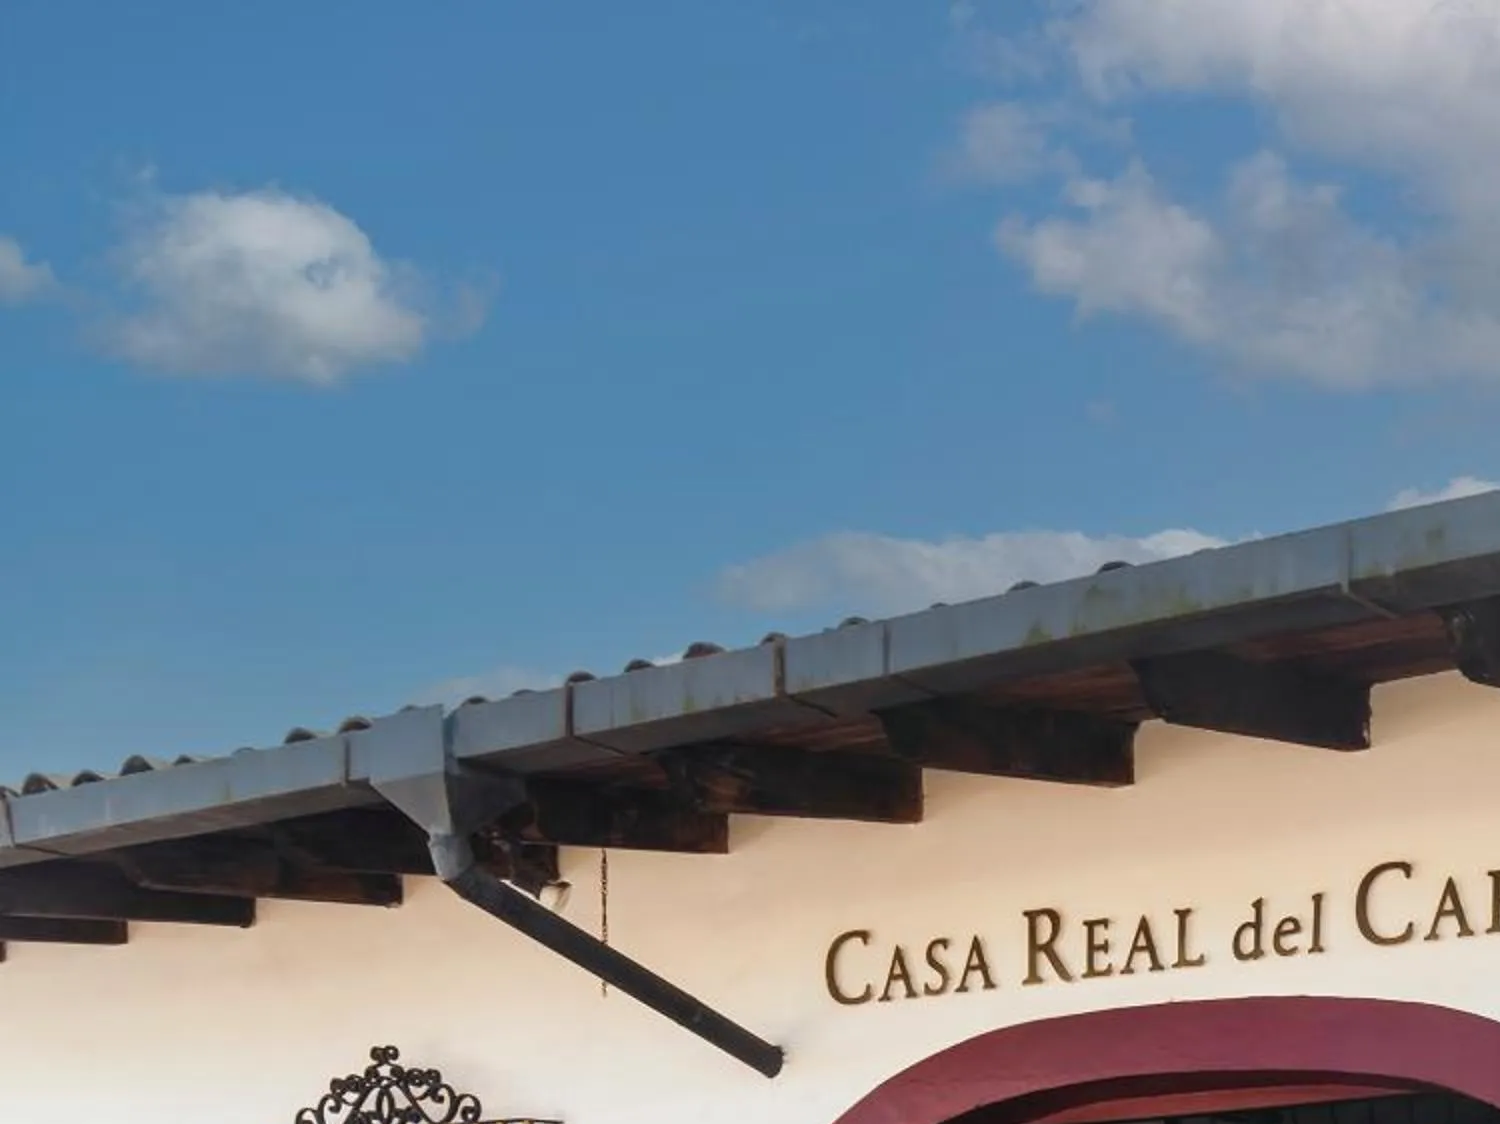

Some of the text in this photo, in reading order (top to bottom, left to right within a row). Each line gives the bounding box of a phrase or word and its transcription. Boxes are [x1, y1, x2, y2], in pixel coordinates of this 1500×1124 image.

[825, 929, 997, 1006] CASA
[1021, 907, 1206, 986] REAL
[1232, 893, 1325, 961] del
